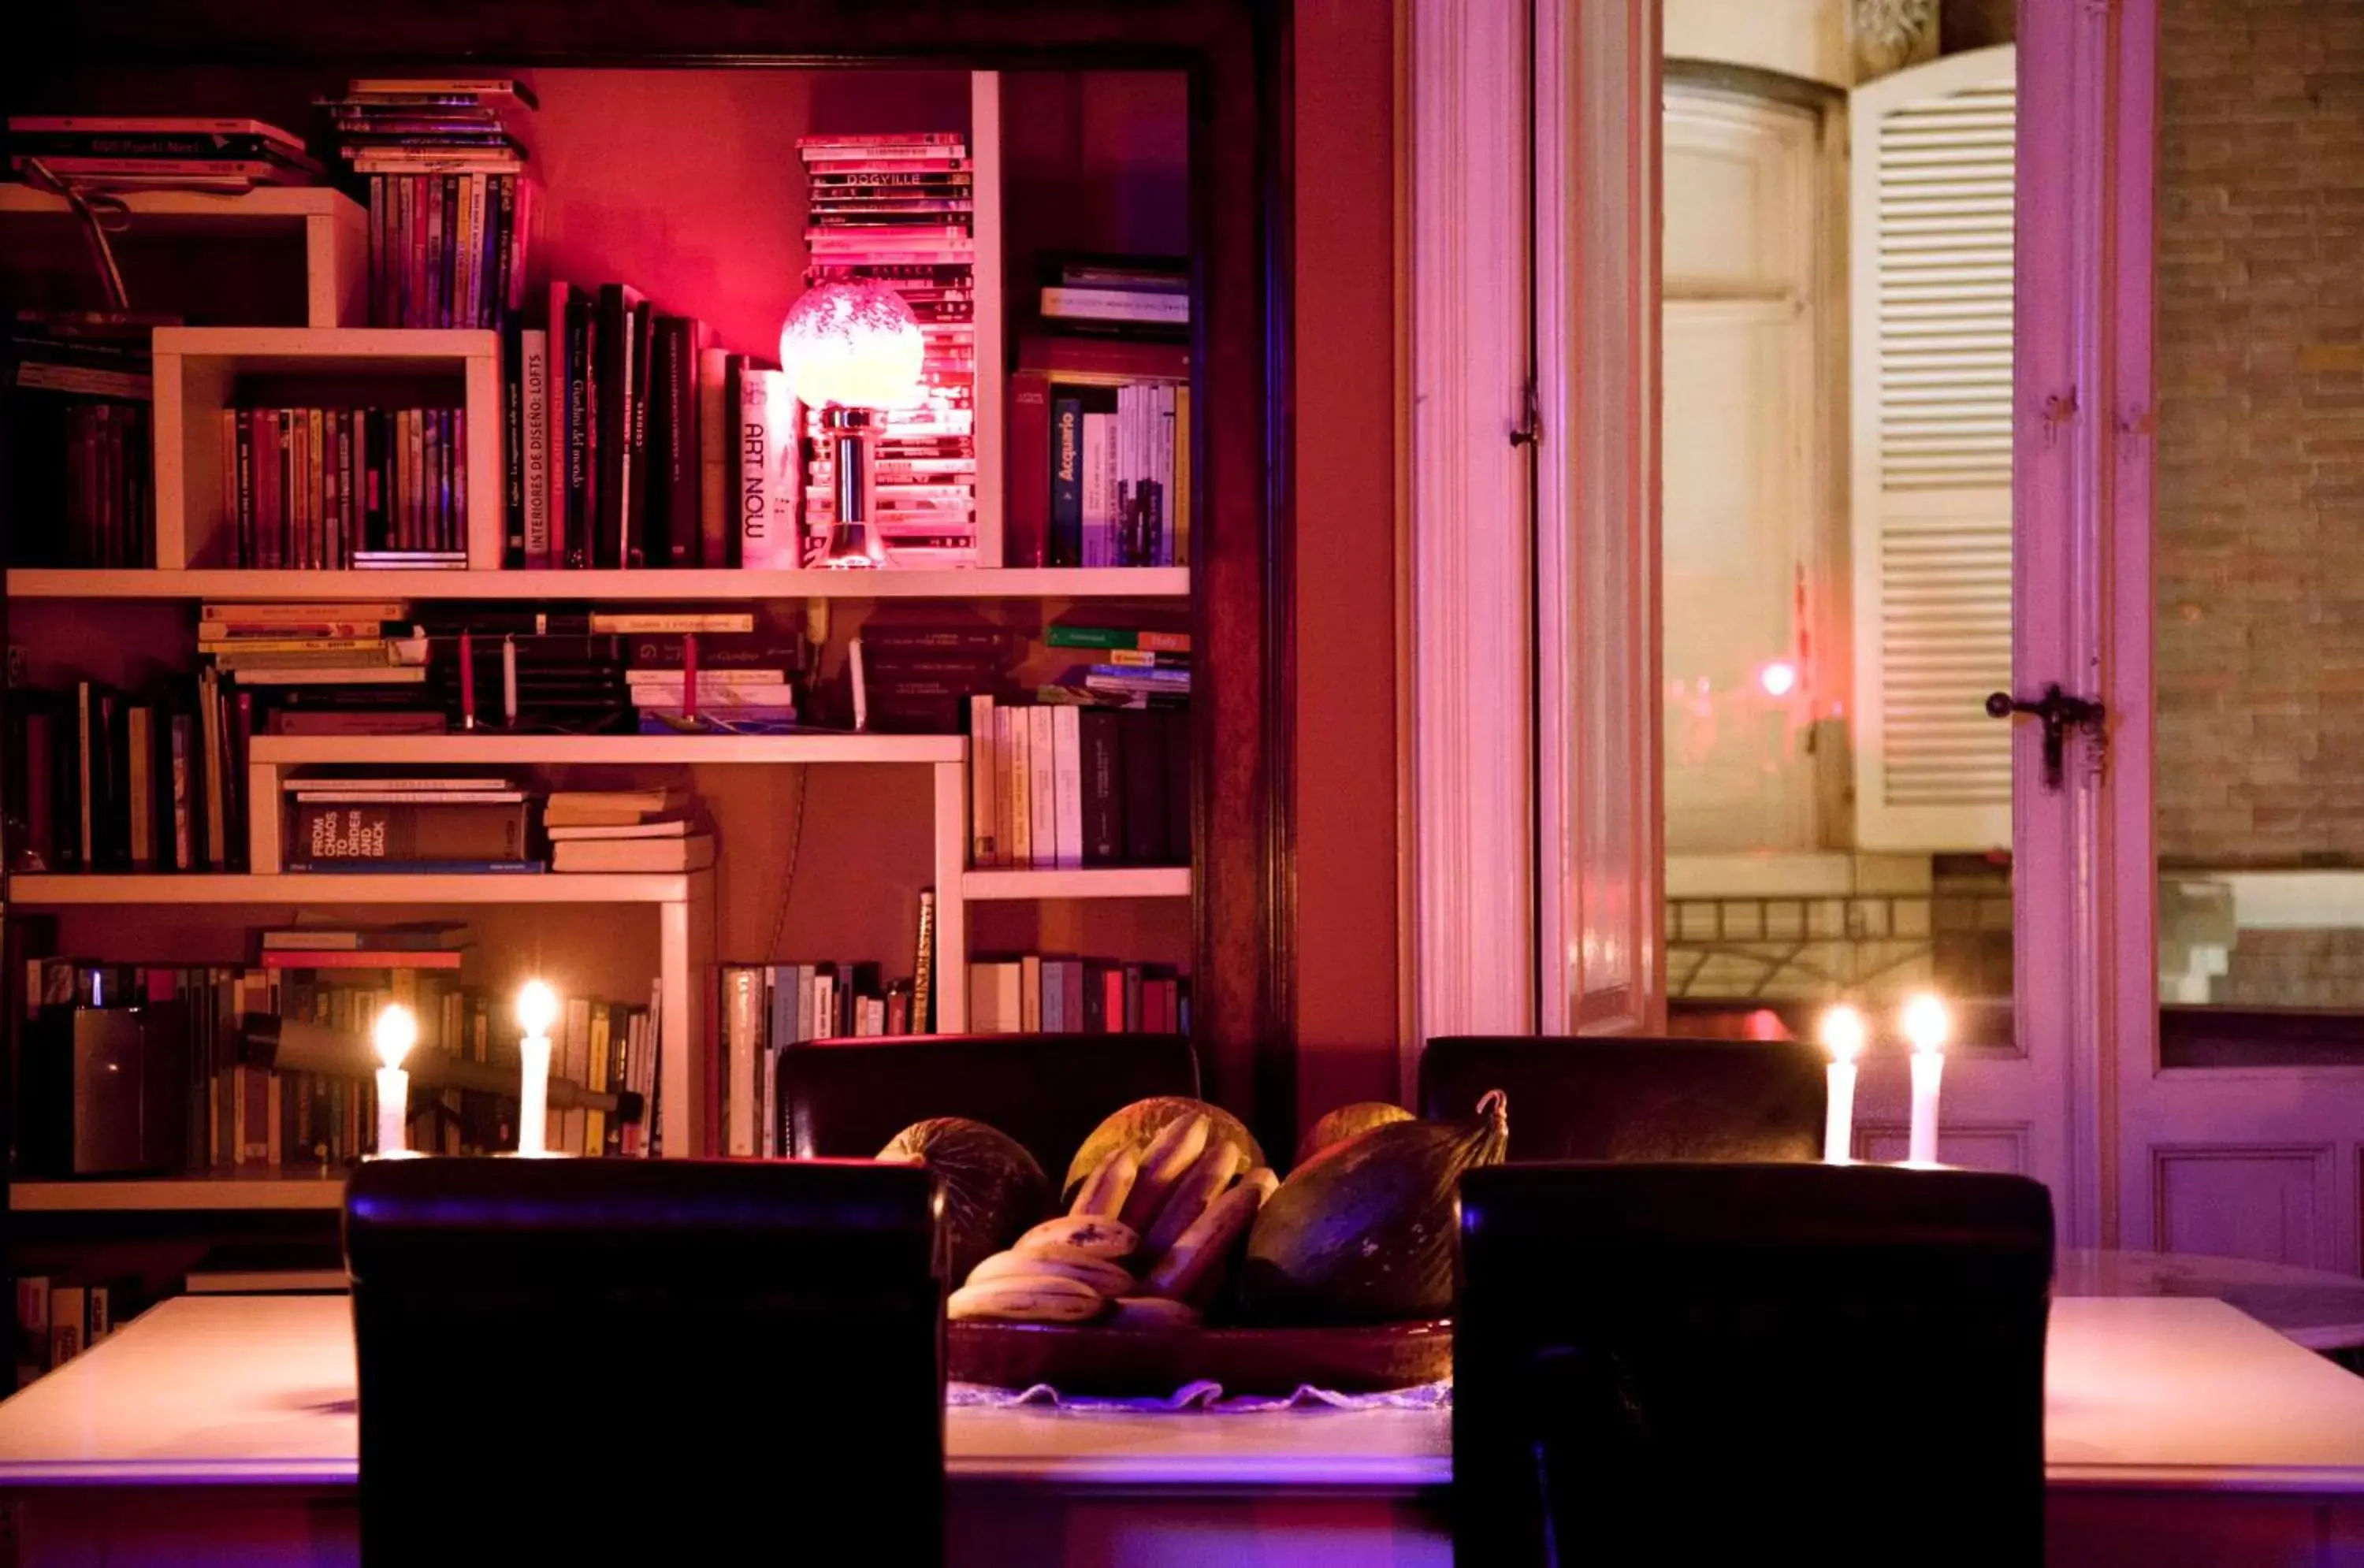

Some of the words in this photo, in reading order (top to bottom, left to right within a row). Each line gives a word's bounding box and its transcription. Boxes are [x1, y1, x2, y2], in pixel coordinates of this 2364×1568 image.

[846, 174, 921, 185] DOGVILLE
[528, 354, 541, 396] LOFTS
[572, 378, 585, 426] Giardini
[527, 397, 542, 451] DISEÑO:
[572, 429, 585, 446] del
[529, 453, 541, 470] DE
[745, 422, 764, 469] ART
[1058, 411, 1076, 481] Acquario
[572, 449, 585, 489] mondo
[530, 474, 542, 548] INTERIORES
[745, 477, 764, 538] NOW
[311, 818, 324, 857] FROM
[324, 811, 336, 857] CHAOS
[336, 839, 348, 857] TO
[348, 811, 360, 857] ORDER
[359, 827, 372, 857] AND
[371, 820, 385, 857] BACK
